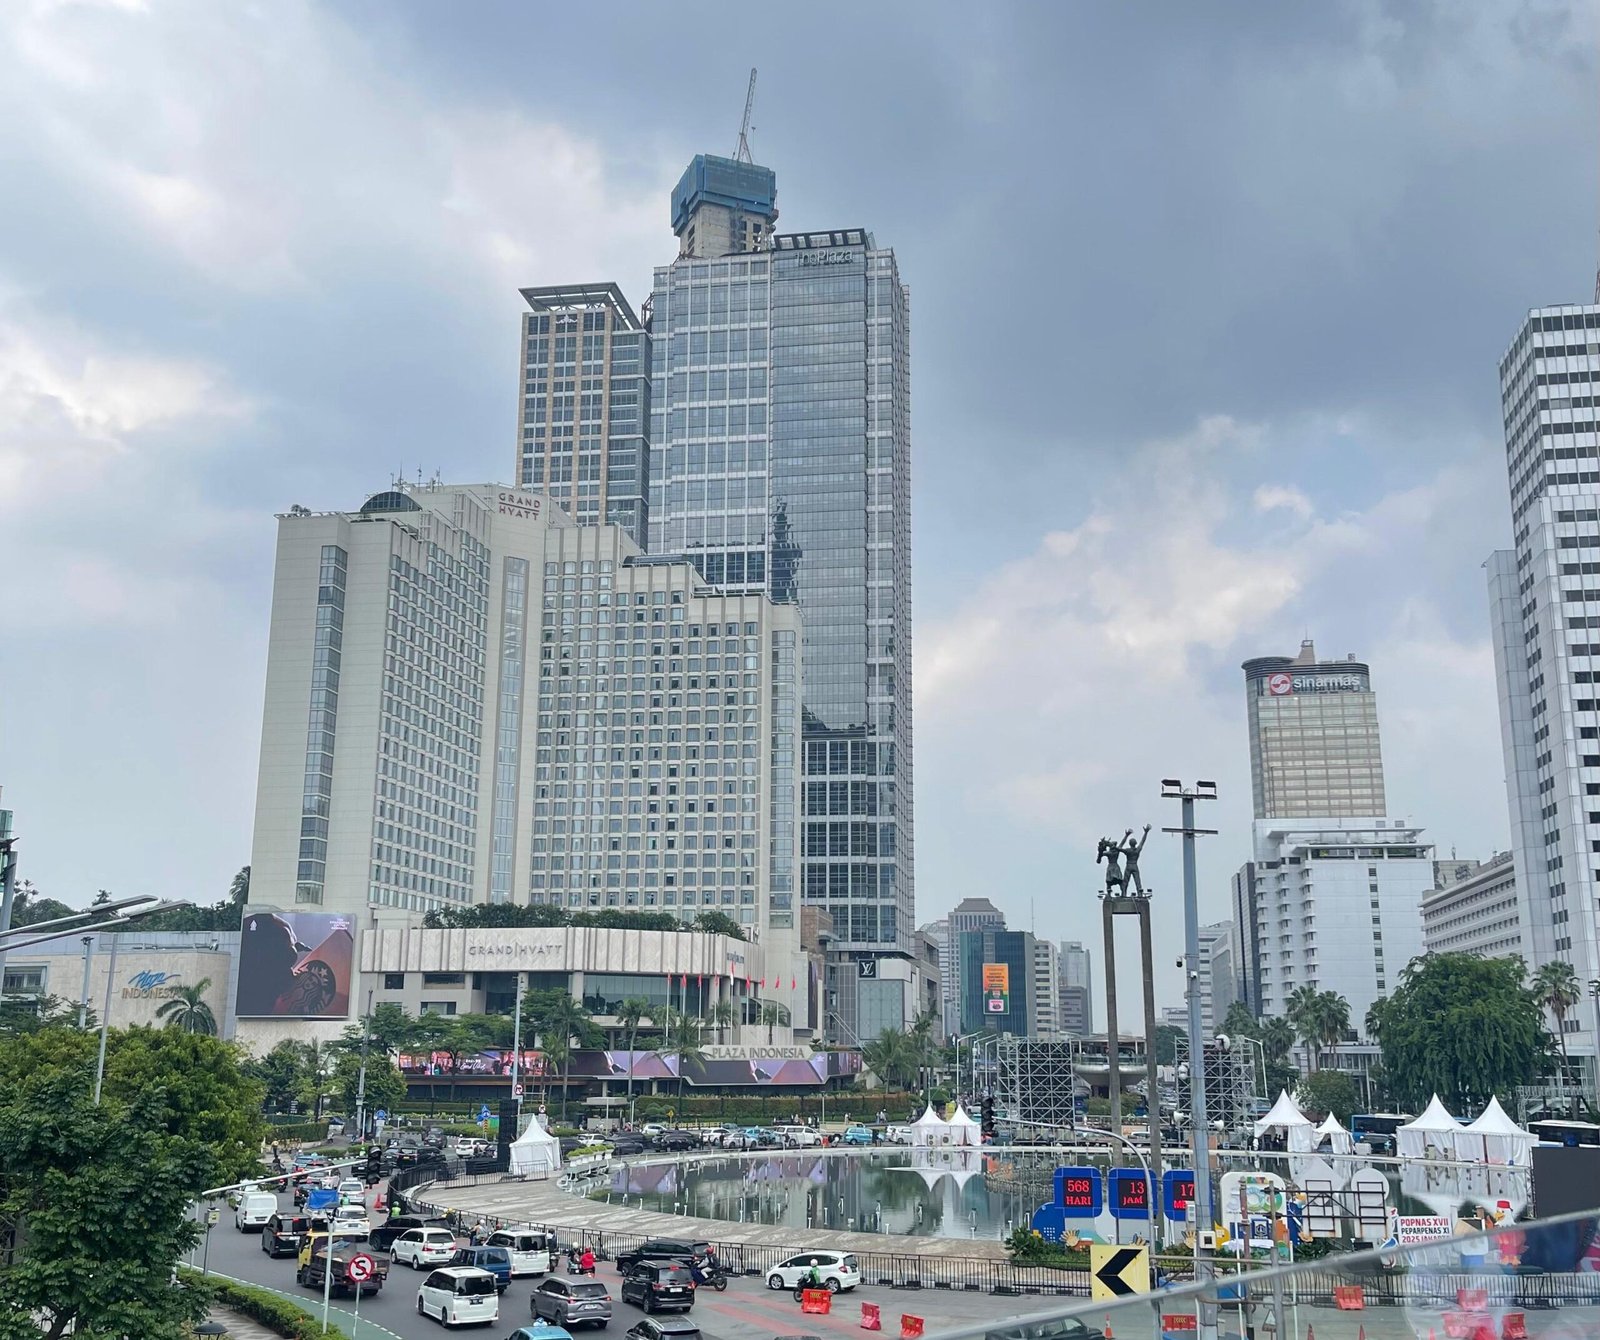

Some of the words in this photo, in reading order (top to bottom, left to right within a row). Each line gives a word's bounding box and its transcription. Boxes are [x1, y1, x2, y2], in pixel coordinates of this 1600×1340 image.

[498, 493, 540, 508] GRAND
[499, 505, 539, 520] HYATT
[1293, 675, 1361, 688] sinarmas
[468, 945, 513, 955] GRAND
[519, 945, 562, 955] HYATT
[712, 1047, 746, 1059] PLAZA
[749, 1047, 805, 1059] INDONESIA
[1067, 1180, 1090, 1192] 568
[1130, 1181, 1145, 1194] 13
[1180, 1183, 1195, 1197] 17
[1066, 1196, 1091, 1205] HARI
[1122, 1195, 1144, 1206] JAM
[1400, 1218, 1432, 1227] POPNAS
[1433, 1218, 1449, 1227] XVII
[1401, 1227, 1442, 1235] PEPARPENAS
[1443, 1227, 1450, 1235] XI
[1402, 1235, 1420, 1243] 2025
